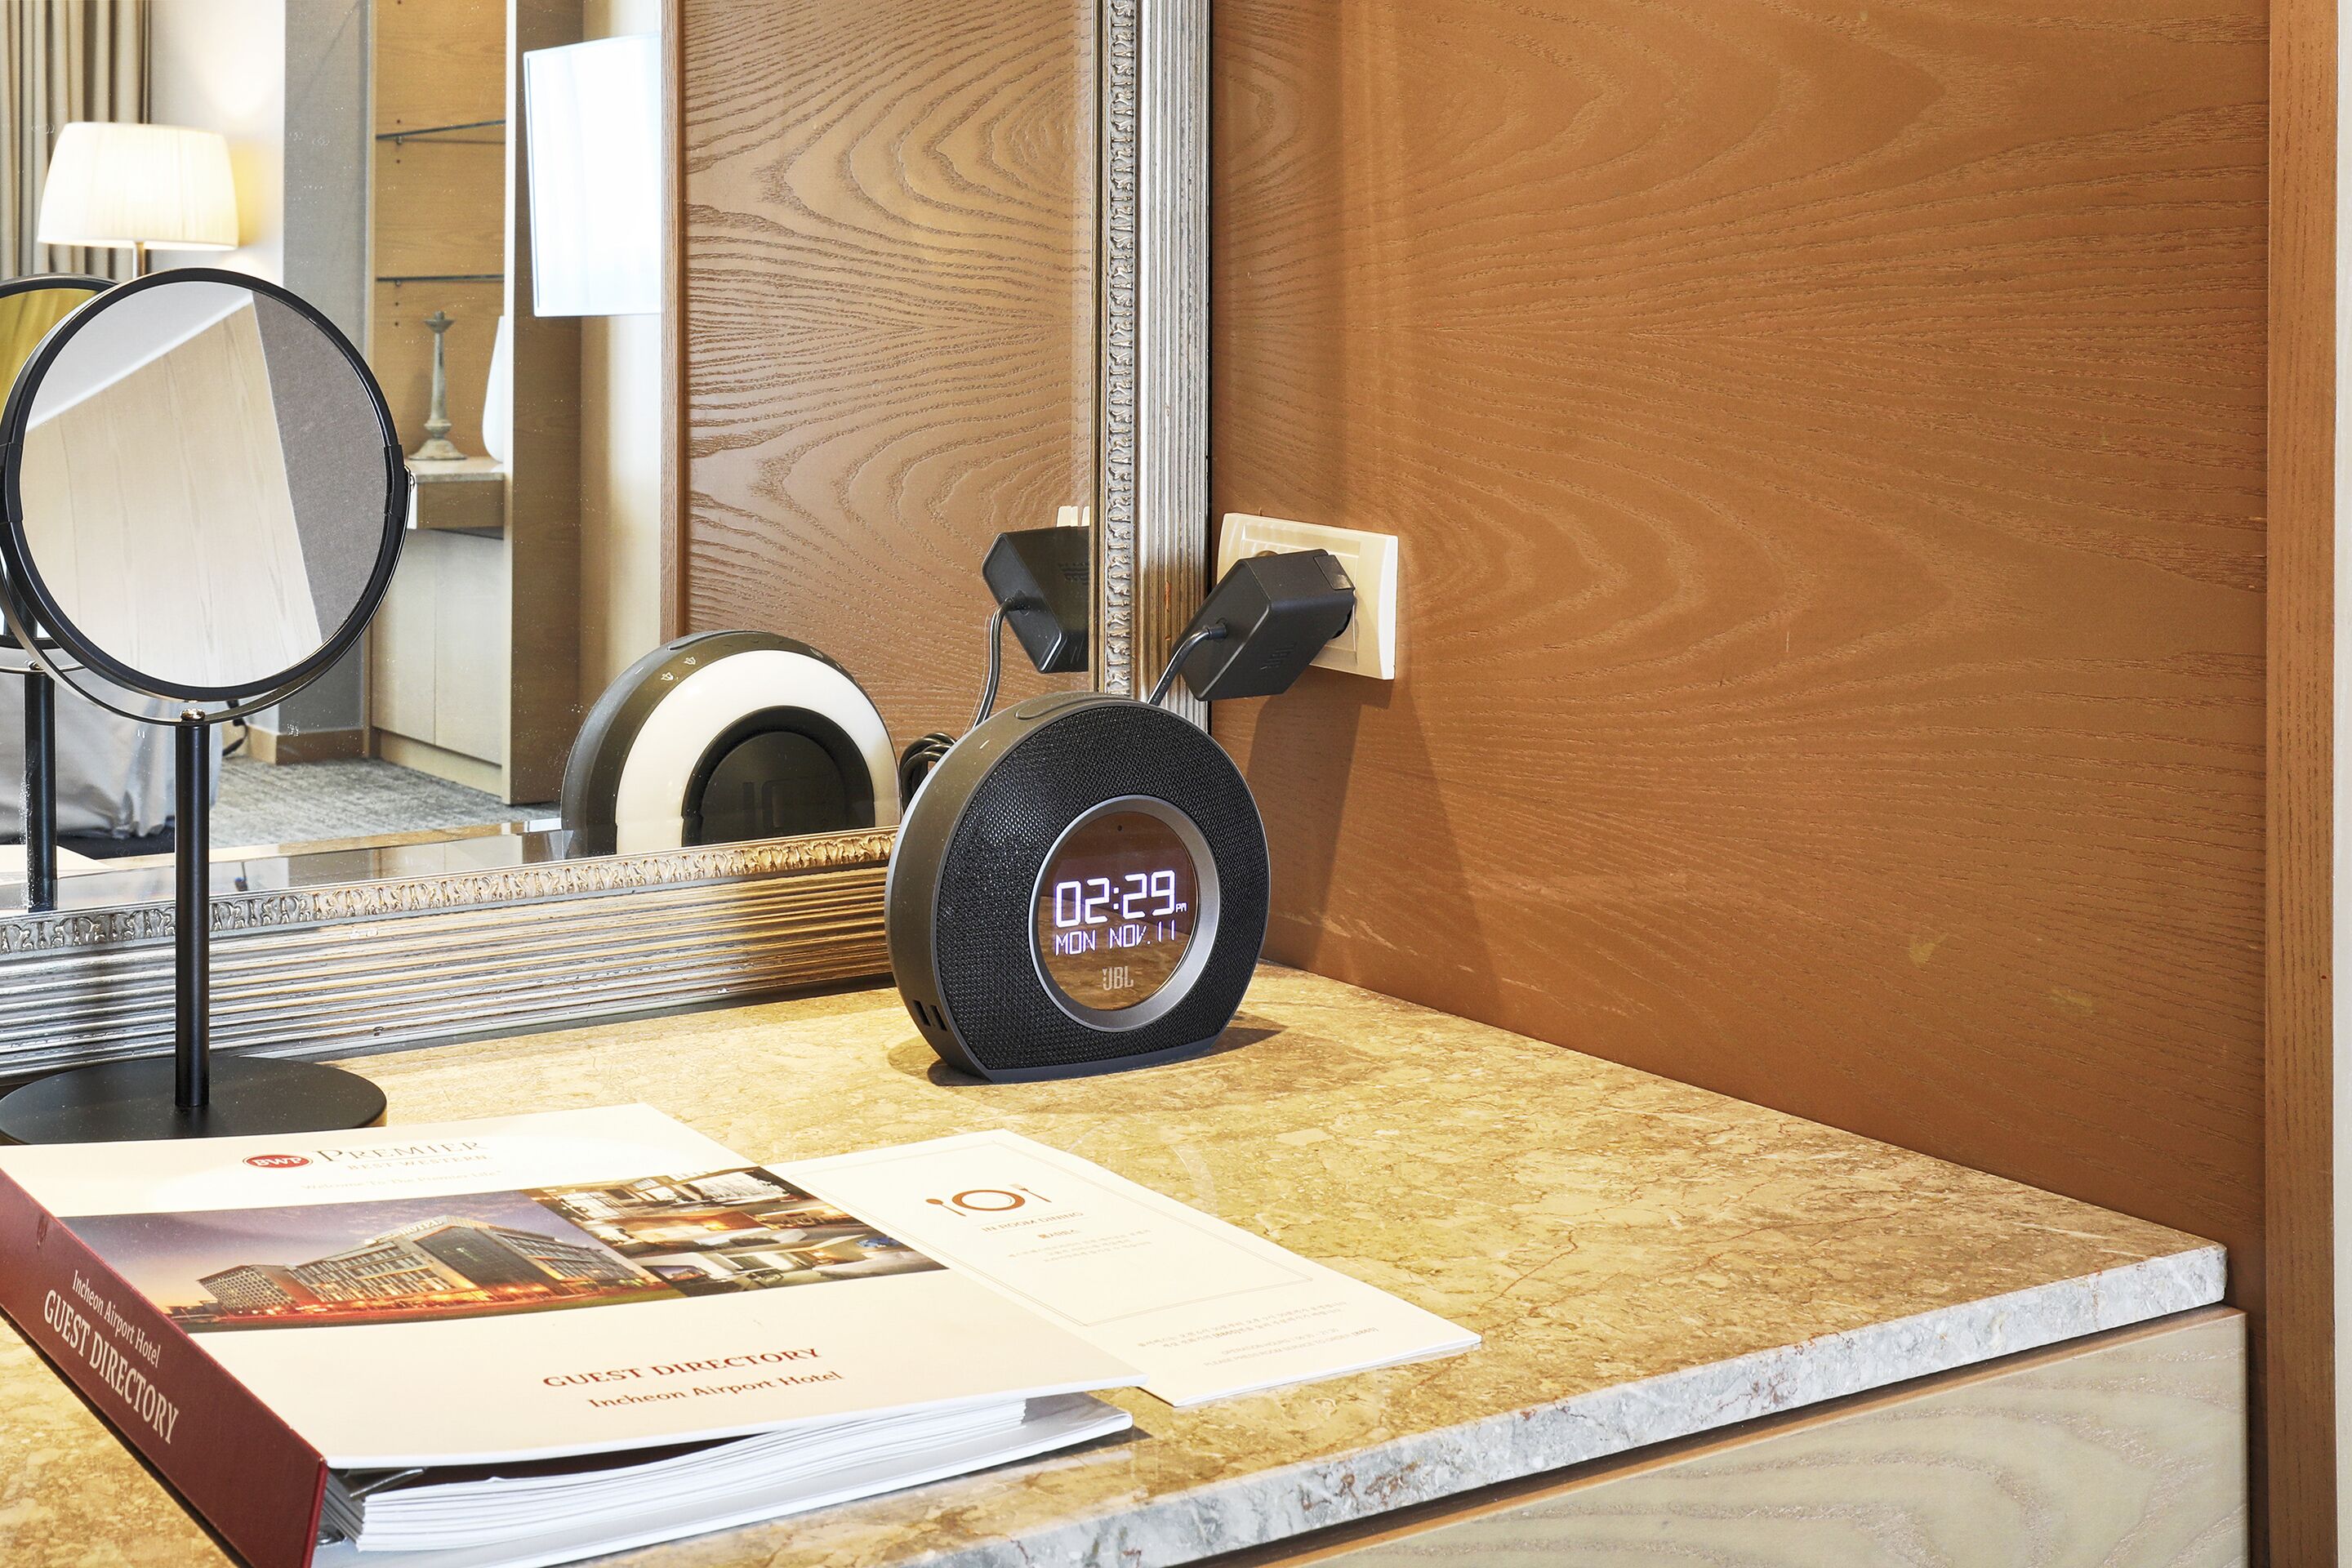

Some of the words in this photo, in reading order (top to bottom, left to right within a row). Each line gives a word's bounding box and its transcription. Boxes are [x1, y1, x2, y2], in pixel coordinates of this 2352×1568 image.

[1055, 870, 1176, 929] 02:29
[1176, 902, 1187, 913] PM
[1054, 929, 1096, 956] MON
[1102, 965, 1134, 991] JBL
[251, 1156, 304, 1167] BWP
[347, 1162, 393, 1170] BEST
[998, 1219, 1037, 1229] ROOM
[72, 1269, 104, 1316] Incheon
[104, 1300, 136, 1344] Airport
[135, 1328, 162, 1369] Hotel
[44, 1290, 91, 1357] GUEST
[89, 1331, 180, 1445] DIRECTORY
[542, 1368, 645, 1388] GUEST
[648, 1348, 822, 1377] DIRECTORY
[586, 1389, 688, 1408] Incheon
[693, 1379, 776, 1396] Airport
[778, 1370, 845, 1387] Hotel
